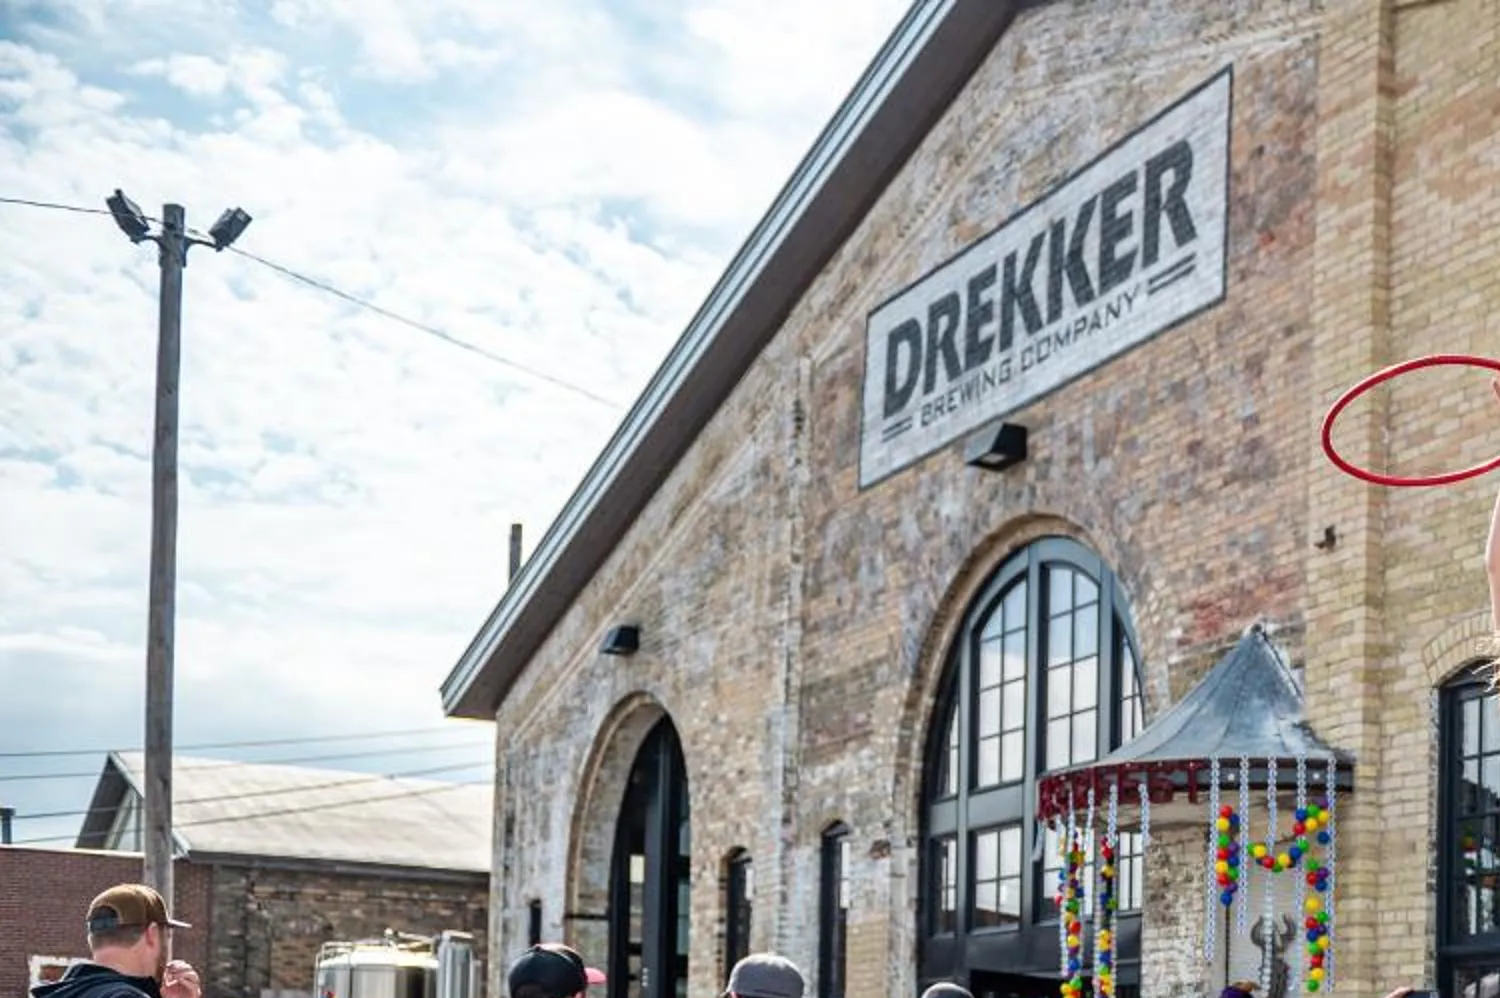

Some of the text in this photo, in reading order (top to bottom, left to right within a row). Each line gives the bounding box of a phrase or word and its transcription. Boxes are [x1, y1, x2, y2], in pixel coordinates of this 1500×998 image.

[882, 140, 1198, 420] DREKKER
[920, 284, 1142, 427] BREWING COMPANY
